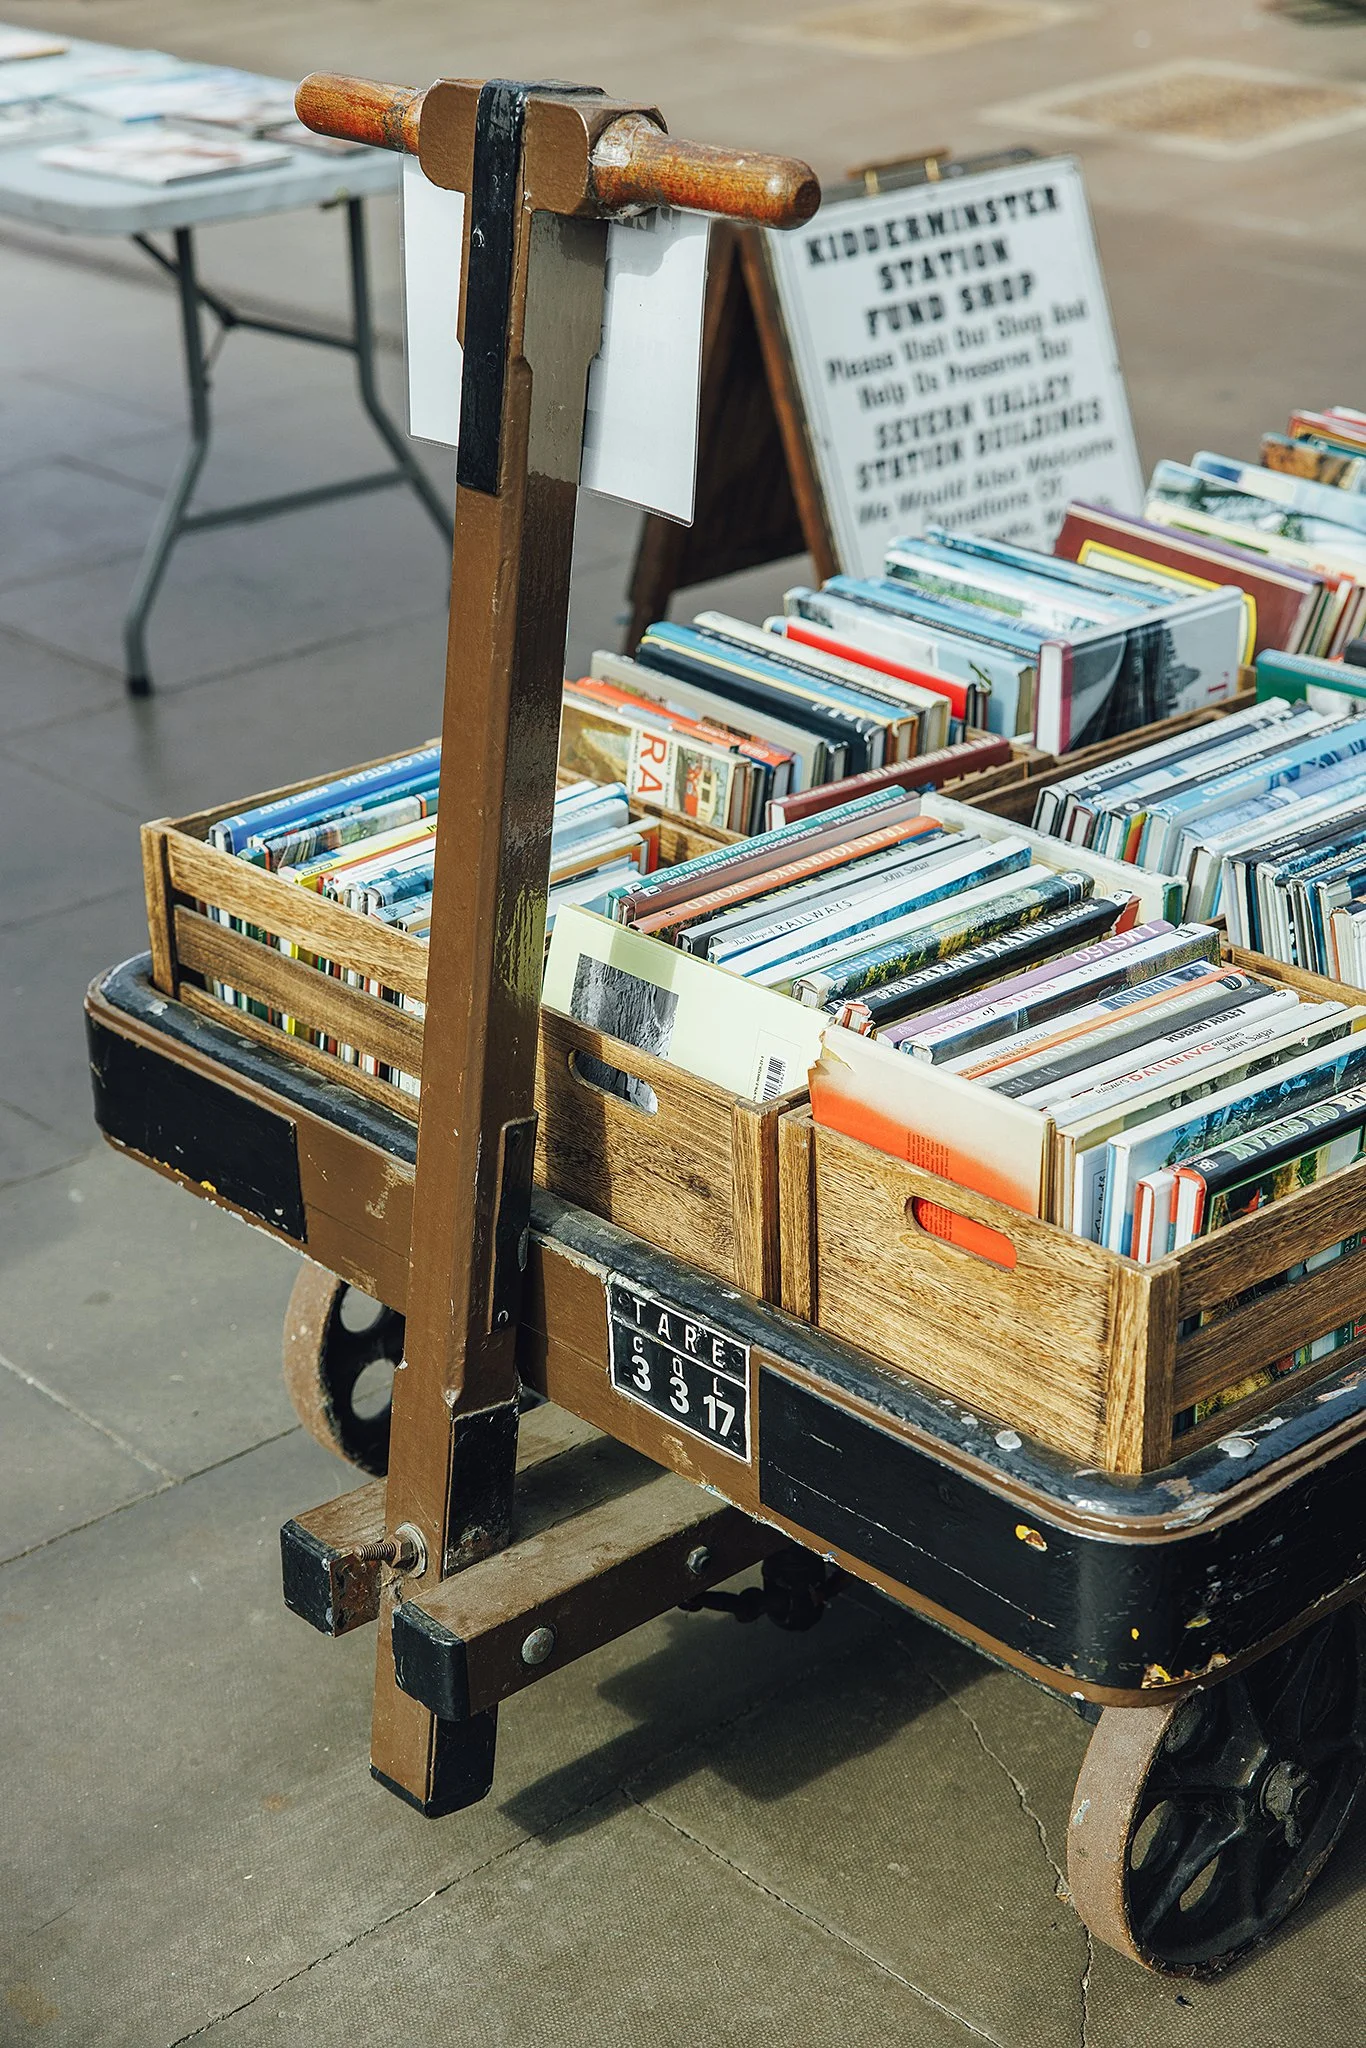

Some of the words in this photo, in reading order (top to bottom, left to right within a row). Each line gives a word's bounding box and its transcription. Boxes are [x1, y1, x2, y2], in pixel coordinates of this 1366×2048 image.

[805, 187, 1059, 265] KIDDERMINSTER
[879, 238, 1010, 291] STATION
[865, 296, 945, 338] FUND
[961, 273, 1035, 314] SHOP
[826, 350, 894, 384] Please
[905, 333, 947, 361] Visit
[956, 325, 986, 350] Our
[997, 310, 1043, 342] Shop
[858, 382, 907, 411] Help
[916, 369, 938, 394] Us
[949, 349, 1031, 384] Preserve
[1040, 340, 1068, 361] Our
[875, 401, 975, 450] SEVERN
[983, 373, 1072, 414] VALLEY
[857, 440, 963, 492] STATION
[975, 400, 1102, 455] BUILDINGS
[896, 477, 965, 513] Would
[974, 465, 1017, 491] Also
[1026, 438, 1114, 474] Welcome
[651, 867, 683, 884] GREAT
[682, 850, 726, 875] RAILWAY
[726, 824, 806, 859] PHOTOGRAPHERS
[816, 808, 847, 823] HENRY
[667, 871, 699, 886] GREAT
[699, 856, 742, 878] RAILWAY
[741, 827, 823, 861] PHOTOGRAPHERS
[833, 809, 873, 825] MAURICE
[768, 846, 855, 881] JOURNEYS
[855, 825, 909, 849] TRAIN
[684, 884, 749, 910] WORLD
[880, 872, 905, 884] John
[905, 862, 931, 875] Sagar
[774, 899, 853, 932] RAILWAYS
[827, 953, 877, 980] LNER
[877, 942, 907, 961] 150
[904, 947, 980, 990] GREAT
[979, 921, 1055, 957] TRAINS
[1052, 914, 1077, 927] Chris
[1076, 903, 1100, 918] Cook
[924, 1015, 977, 1038] SPELL
[982, 1006, 997, 1016] of
[997, 983, 1056, 1008] STEAM
[1079, 963, 1106, 976] ERIC
[1107, 946, 1149, 964] TREACY
[987, 1044, 1015, 1059] TANEL
[1013, 1031, 1050, 1049] FRANCO
[1022, 1018, 1138, 1067] RENAISSANCE
[1146, 1007, 1167, 1019] Tom
[1163, 1021, 1211, 1043] ROBERT
[1209, 1008, 1247, 1026] ADLEY
[1222, 1040, 1247, 1054] John
[1249, 1027, 1275, 1043] Sagar
[959, 1061, 990, 1076] REATH
[1226, 1119, 1310, 1161] STEAM
[1304, 1106, 1341, 1127] ON
[632, 1297, 726, 1368] TARE
[631, 1355, 652, 1392] 3
[669, 1376, 690, 1414] 3
[703, 1394, 736, 1437] 17
[633, 1336, 643, 1354] C
[713, 1376, 725, 1398] L
